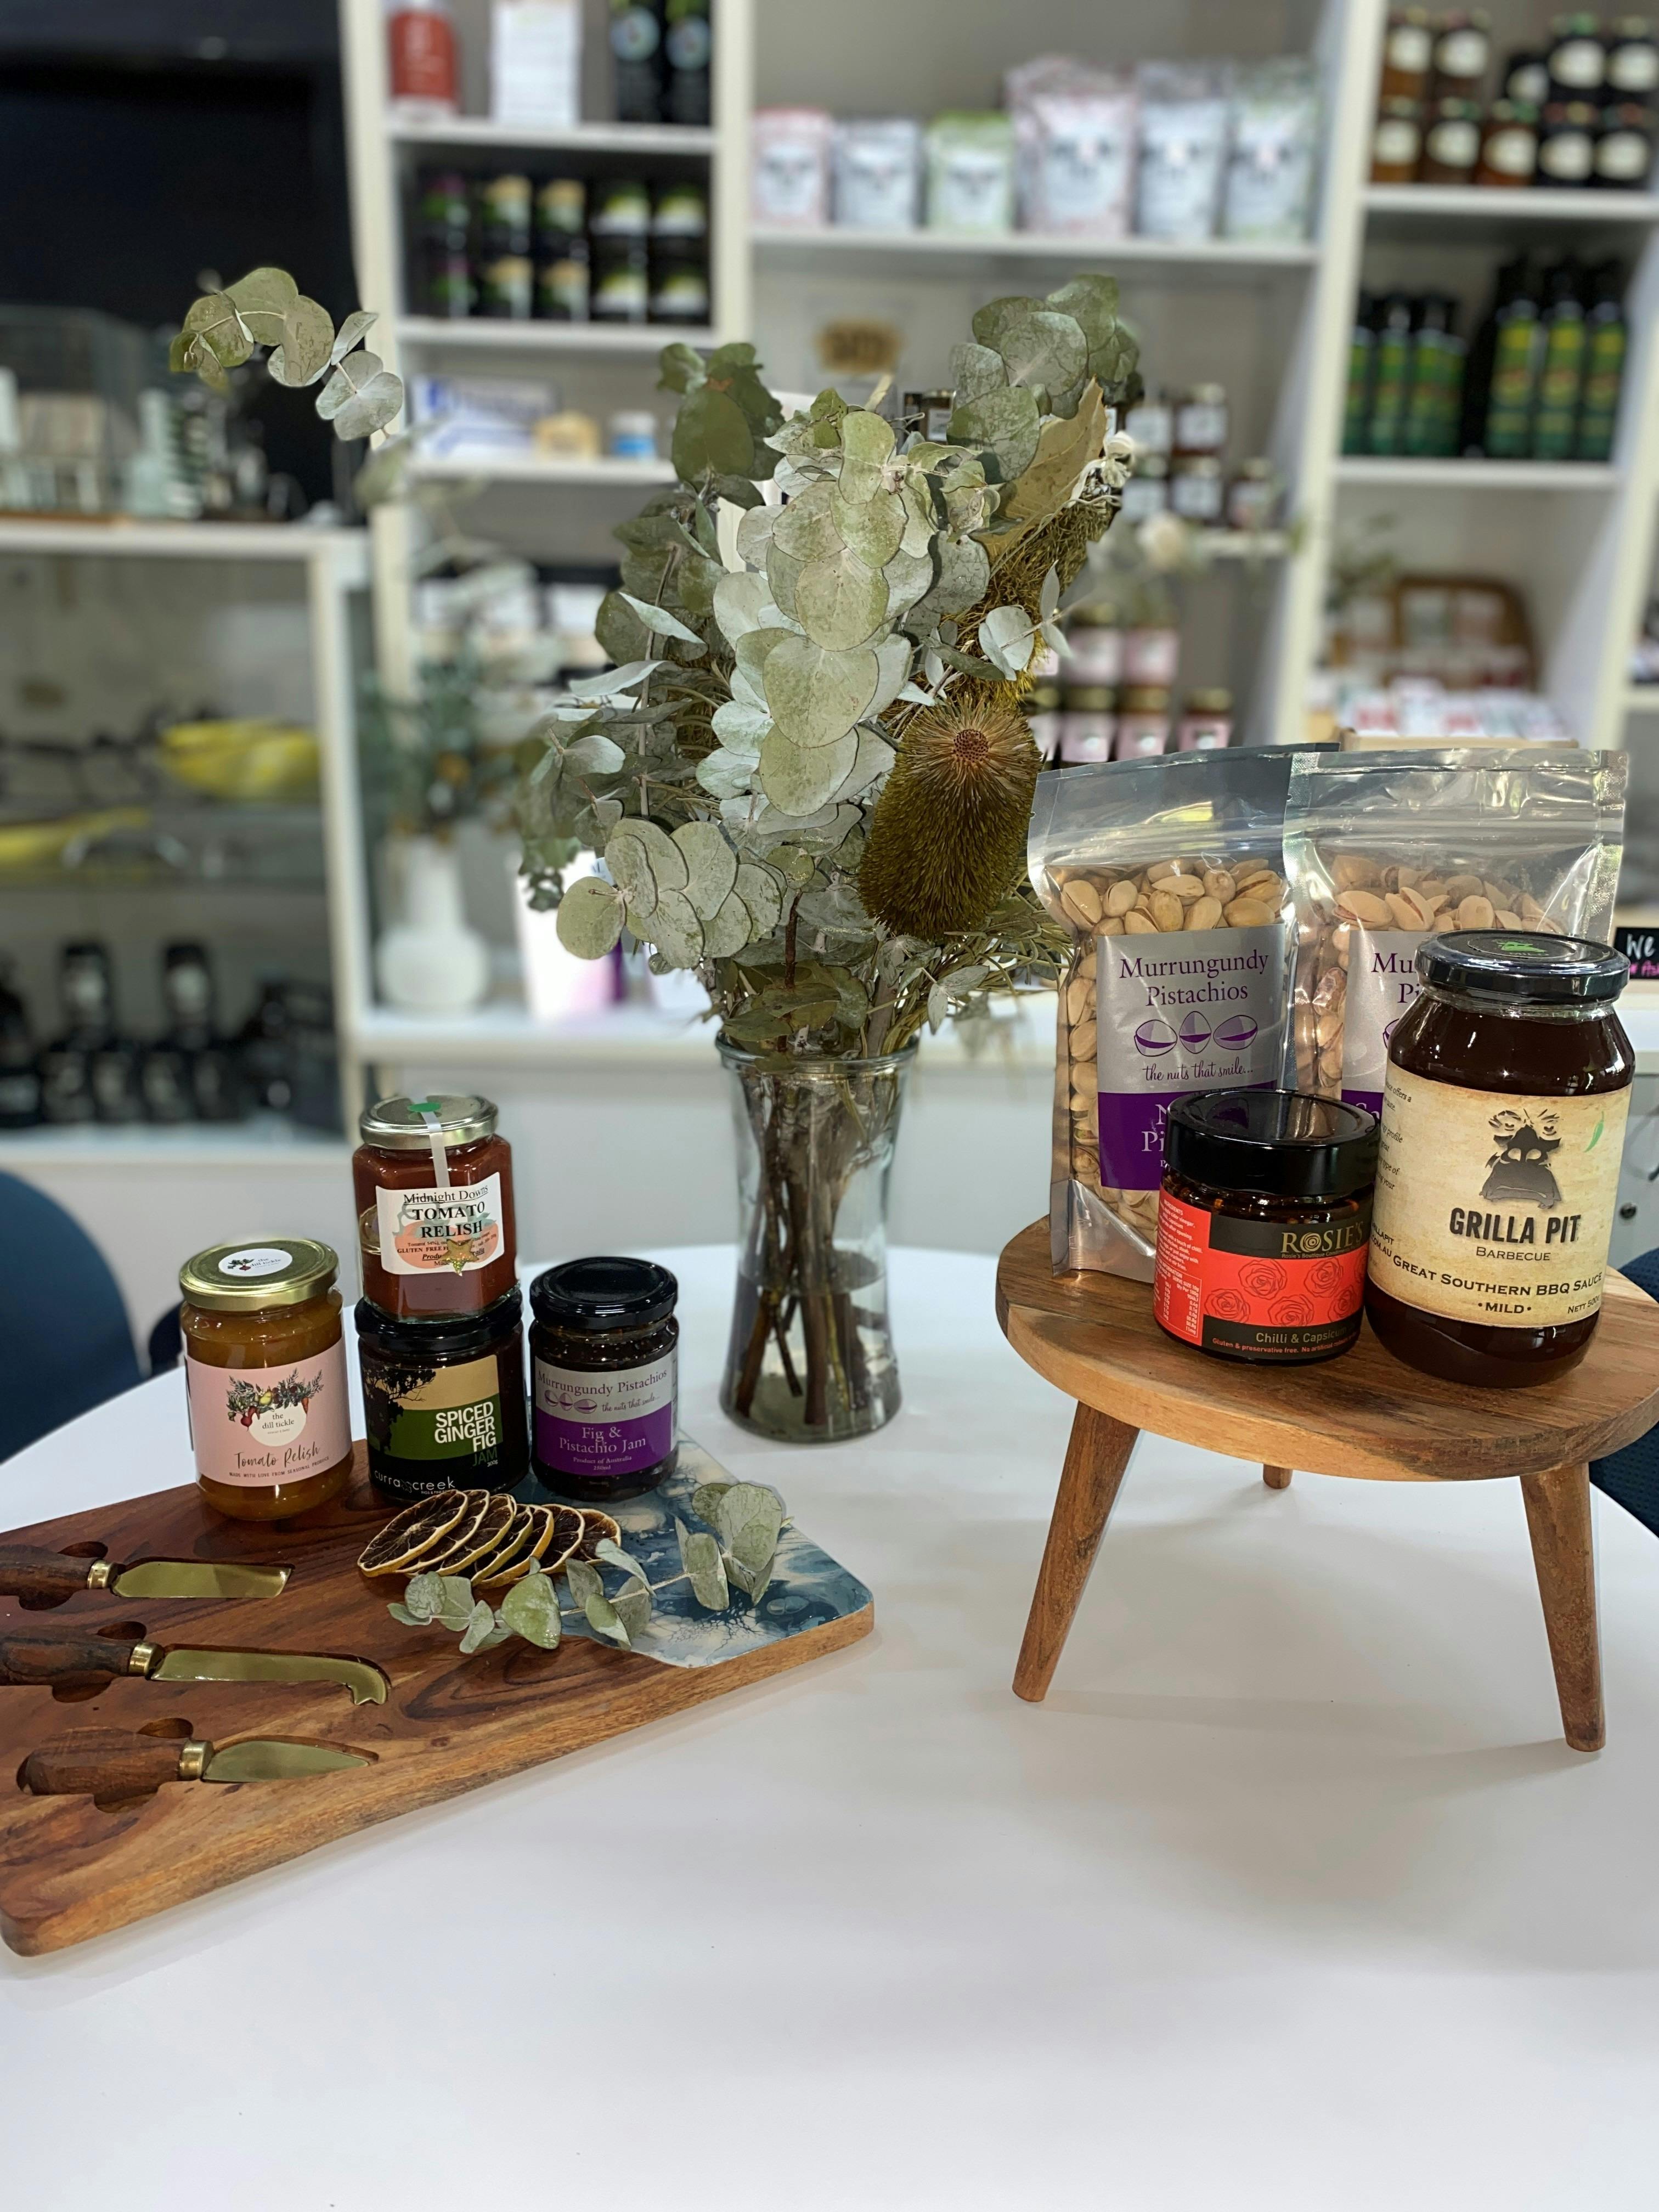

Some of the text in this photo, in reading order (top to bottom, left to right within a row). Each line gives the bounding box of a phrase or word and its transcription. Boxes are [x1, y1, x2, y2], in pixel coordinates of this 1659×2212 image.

[1119, 949, 1268, 979] Murrungundy
[1146, 981, 1248, 1006] Pistachios
[1142, 1057, 1253, 1081] the nuts that smile...
[1392, 1087, 1407, 1102] offers
[1387, 1128, 1403, 1143] profile
[1383, 1178, 1395, 1190] your
[404, 1185, 488, 1204] Midnight Downs
[412, 1201, 485, 1221] TOMATO
[421, 1220, 483, 1238] RELISH
[1449, 1207, 1581, 1244] GRILLA PIT
[1280, 1221, 1364, 1253] ROSIE'S
[1393, 1255, 1602, 1296] GREAT SOUTHERN BBQ SAUCE
[1212, 1338, 1233, 1347] Gluten
[1242, 1345, 1283, 1353] preservative
[1256, 1332, 1287, 1344] Chilli
[1291, 1334, 1299, 1344] &
[538, 1369, 667, 1397] Murrungundy Pistachios
[435, 1401, 493, 1427] SPICED
[602, 1404, 612, 1412] the
[628, 1399, 640, 1408] that
[276, 1419, 295, 1427] tickle
[435, 1416, 495, 1444] GINGER
[472, 1431, 496, 1452] FIG
[582, 1426, 622, 1442] Fig &
[234, 1441, 320, 1469] Tomato Relish
[559, 1437, 646, 1453] Pistachio Jam
[472, 1447, 498, 1467] JAM
[606, 1455, 632, 1464] Australia
[287, 1465, 310, 1475] SEASONAL
[374, 1470, 456, 1491] curra creek
